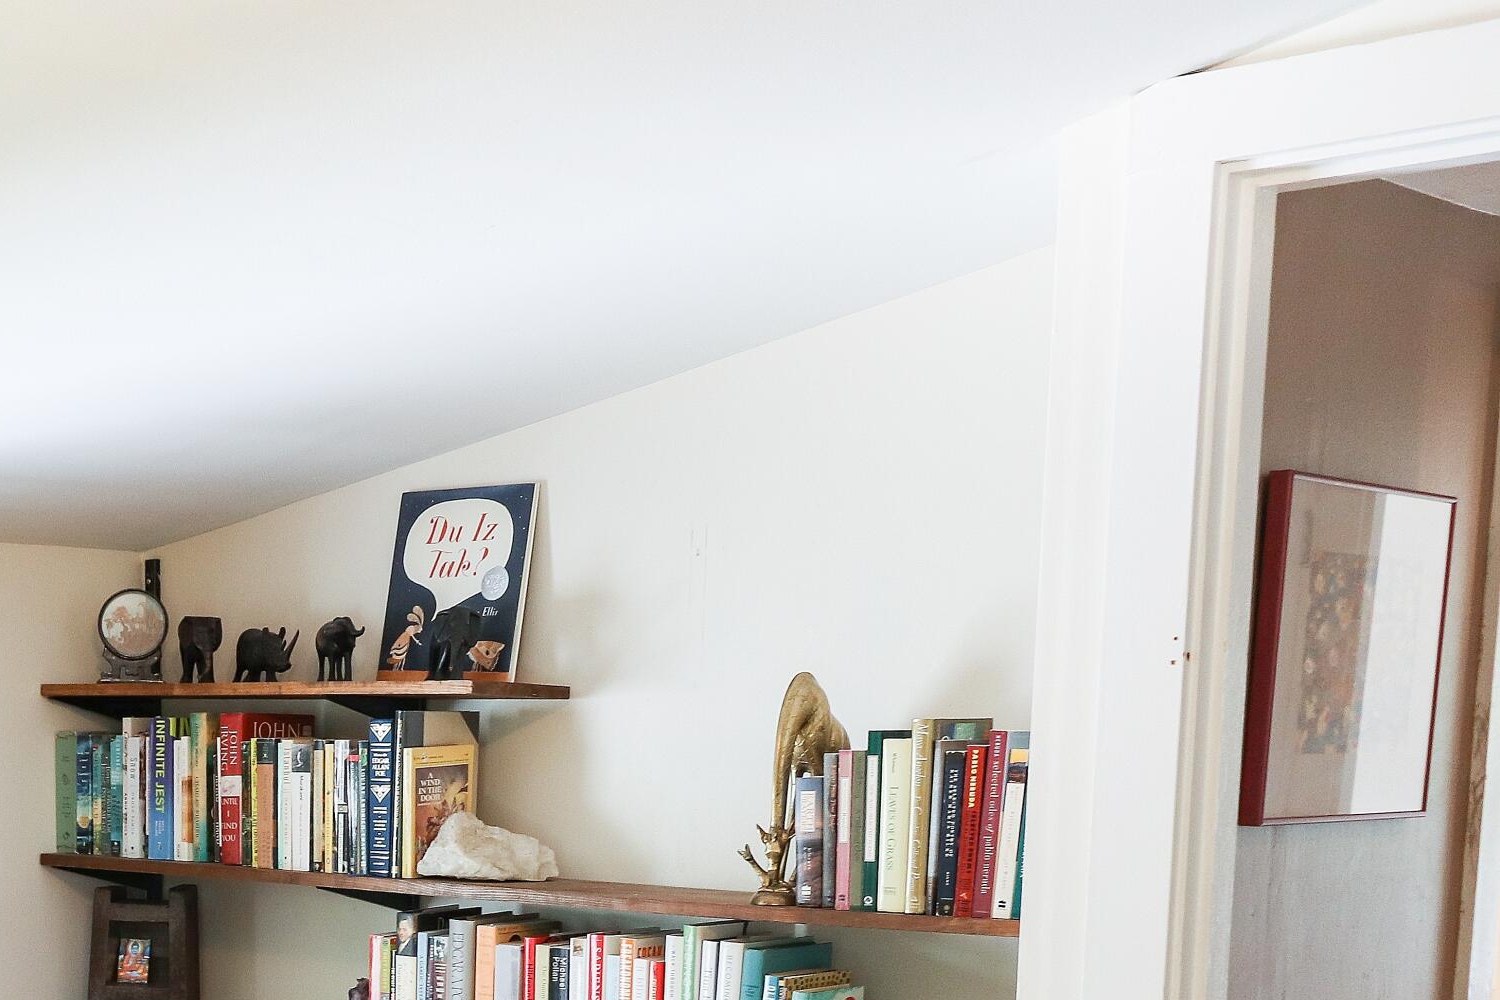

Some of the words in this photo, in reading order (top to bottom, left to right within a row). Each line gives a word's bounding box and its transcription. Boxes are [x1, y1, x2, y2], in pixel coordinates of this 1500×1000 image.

[425, 515, 463, 545] Du
[471, 512, 499, 542] Iz
[428, 546, 490, 579] Tak?
[253, 721, 301, 738] JOHN
[155, 718, 165, 778] INFINITE
[220, 725, 229, 772] IRVING
[229, 730, 239, 765] JOHN
[969, 749, 980, 775] PABLO
[420, 779, 441, 787] WIND
[967, 775, 978, 809] NERUDA
[988, 760, 1001, 797] selected
[155, 781, 165, 814] JEST
[419, 794, 441, 802] DOOR
[986, 800, 998, 821] odes
[982, 836, 993, 861] pablo
[979, 863, 991, 895] neruda
[451, 932, 465, 973] EDGAR
[551, 956, 560, 982] Pollan
[559, 957, 567, 990] Michael
